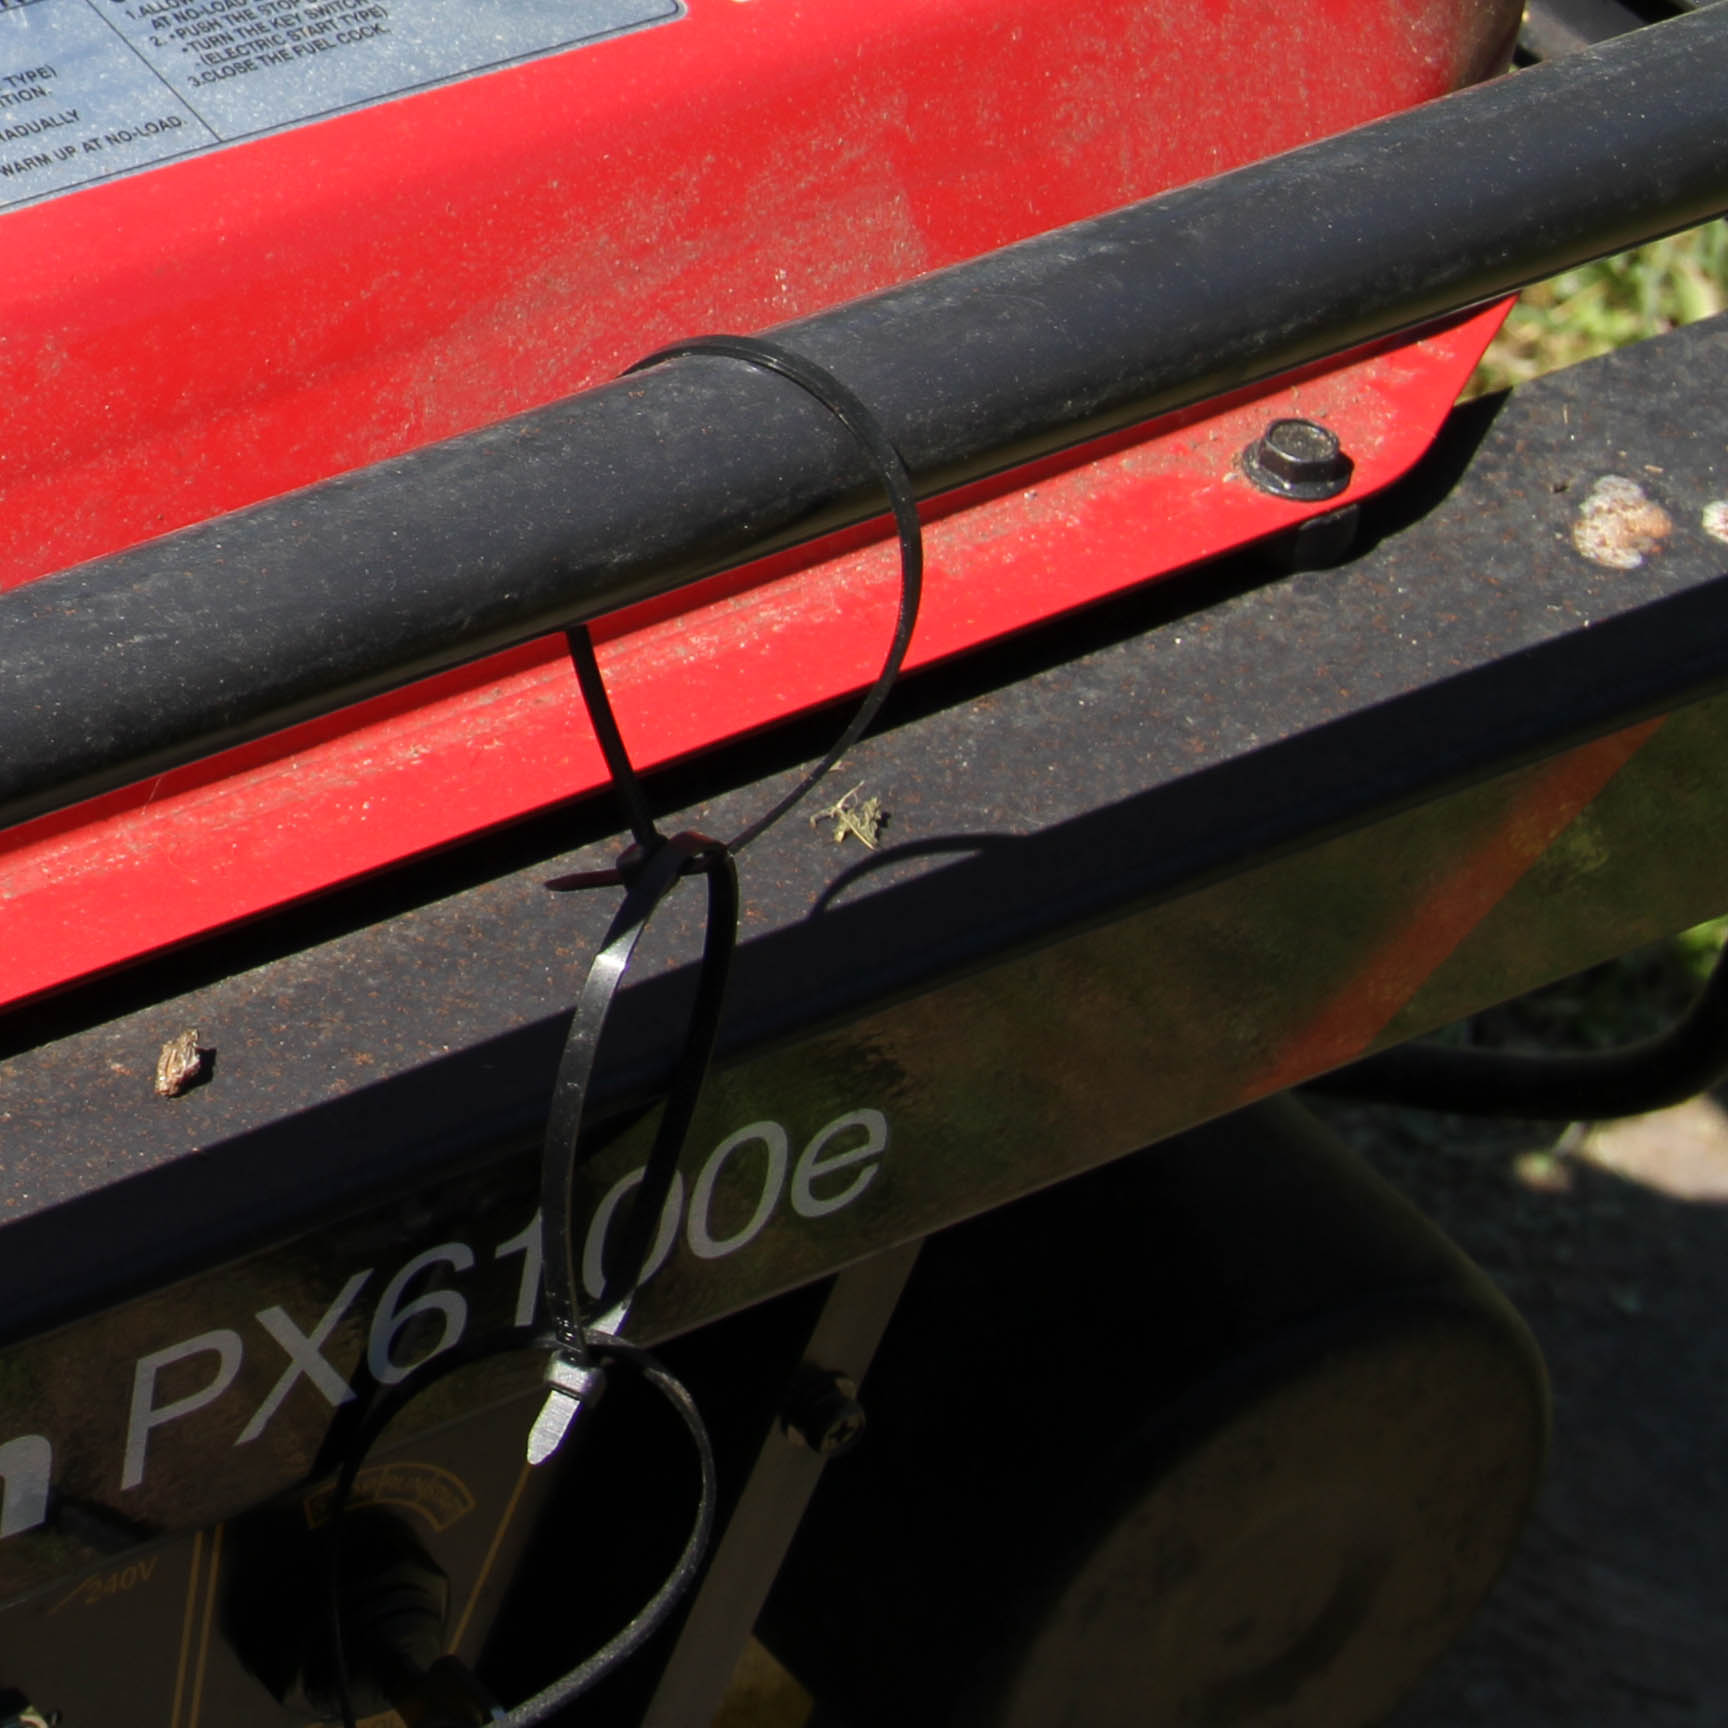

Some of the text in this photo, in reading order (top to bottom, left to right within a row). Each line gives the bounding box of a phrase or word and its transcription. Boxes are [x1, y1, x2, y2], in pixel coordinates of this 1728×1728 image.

[254, 48, 295, 67] THE
[291, 37, 338, 58] FUEL
[52, 144, 77, 162] UP
[81, 136, 104, 154] AT
[119, 1107, 890, 1491] PX6100e
